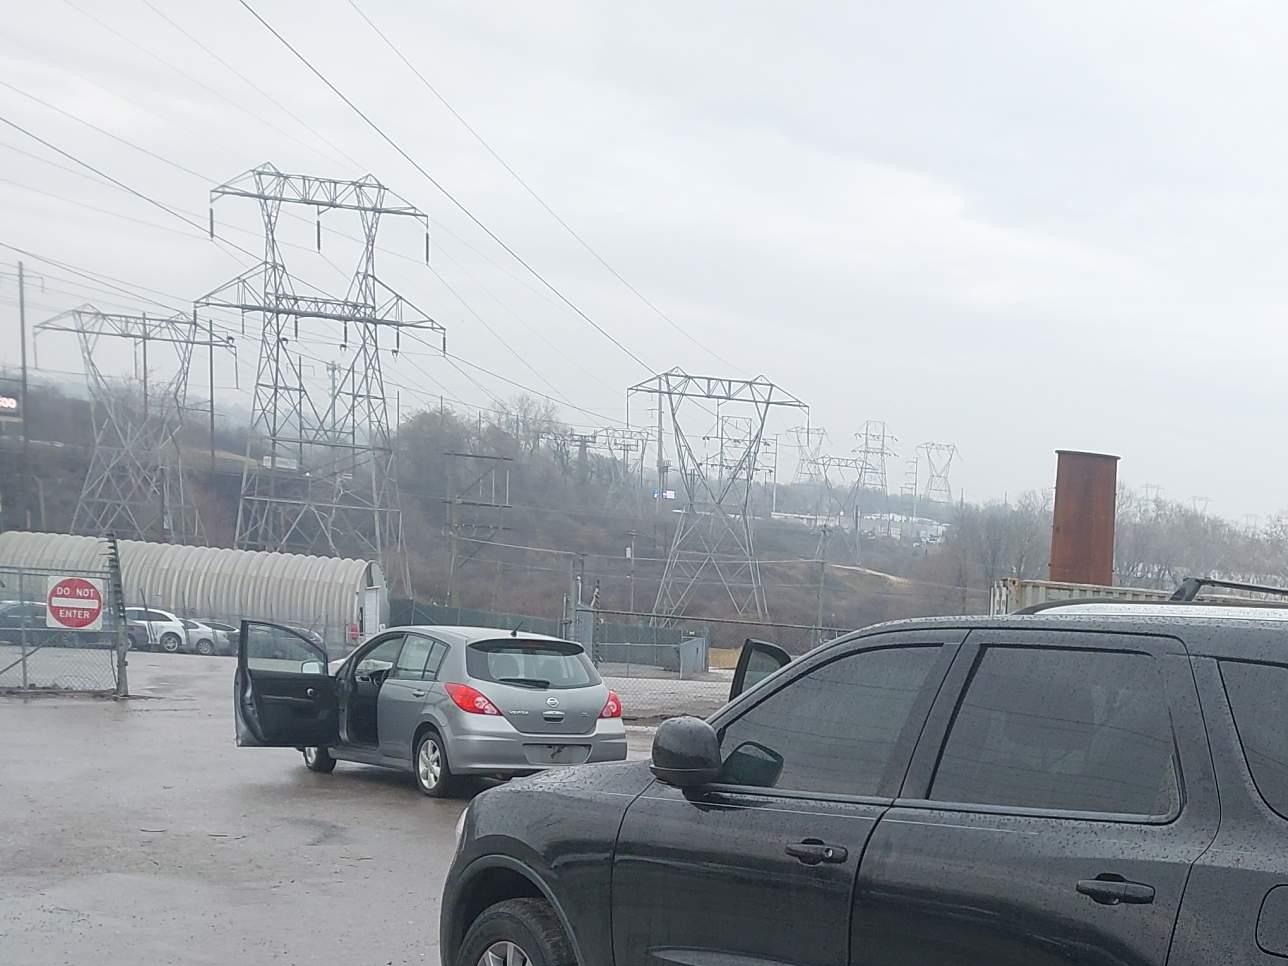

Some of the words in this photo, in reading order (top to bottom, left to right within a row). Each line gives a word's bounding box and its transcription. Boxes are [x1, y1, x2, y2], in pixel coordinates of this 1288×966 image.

[56, 586, 71, 596] DO
[76, 587, 95, 598] NOT
[59, 609, 90, 619] ENTER
